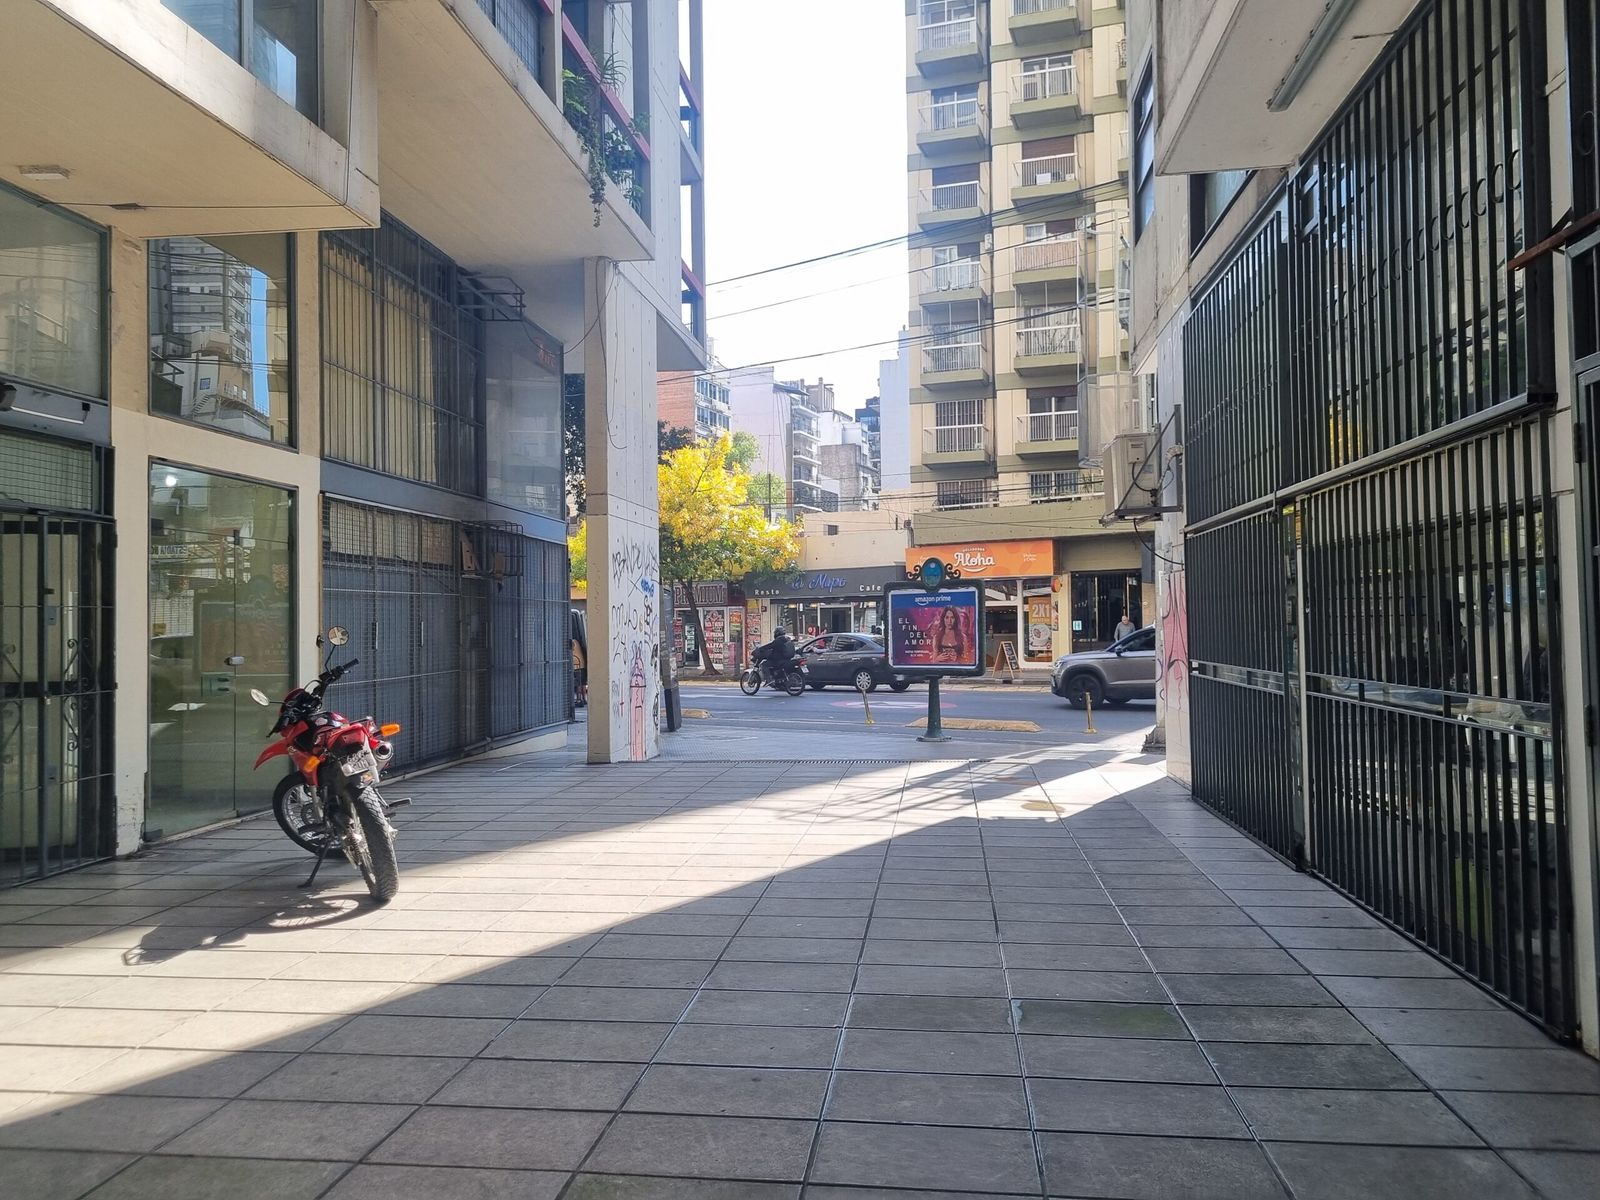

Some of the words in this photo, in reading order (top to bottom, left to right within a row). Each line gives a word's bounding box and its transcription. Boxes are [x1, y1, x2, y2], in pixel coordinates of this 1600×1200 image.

[954, 552, 996, 567] Aloha
[859, 584, 882, 592] Cafe
[674, 585, 724, 604] PRMIUM
[935, 595, 952, 603] prime
